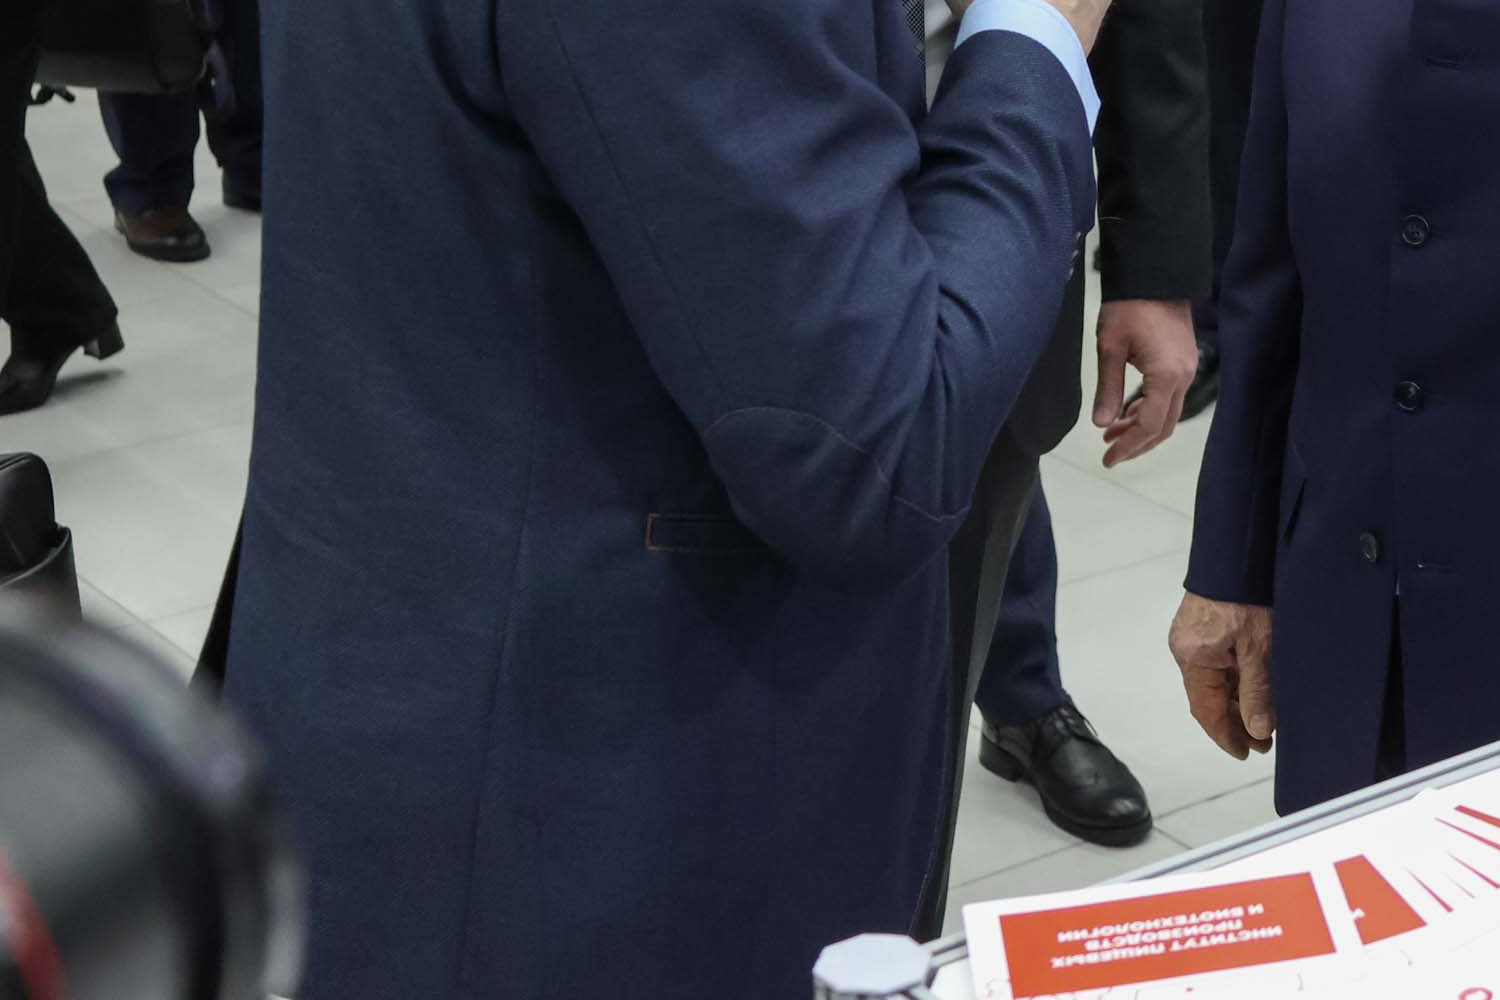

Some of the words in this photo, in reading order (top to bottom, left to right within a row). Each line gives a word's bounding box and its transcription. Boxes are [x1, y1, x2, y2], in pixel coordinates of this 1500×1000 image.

[1247, 903, 1264, 916] И
[1057, 905, 1245, 943] БИОТЕХНОЛОГИИ
[1083, 919, 1243, 952] ПРОИЗВОДСТВ
[1169, 925, 1283, 952] ИНСТИТУТ
[1050, 942, 1165, 968] ПИЩЕВЫХ
